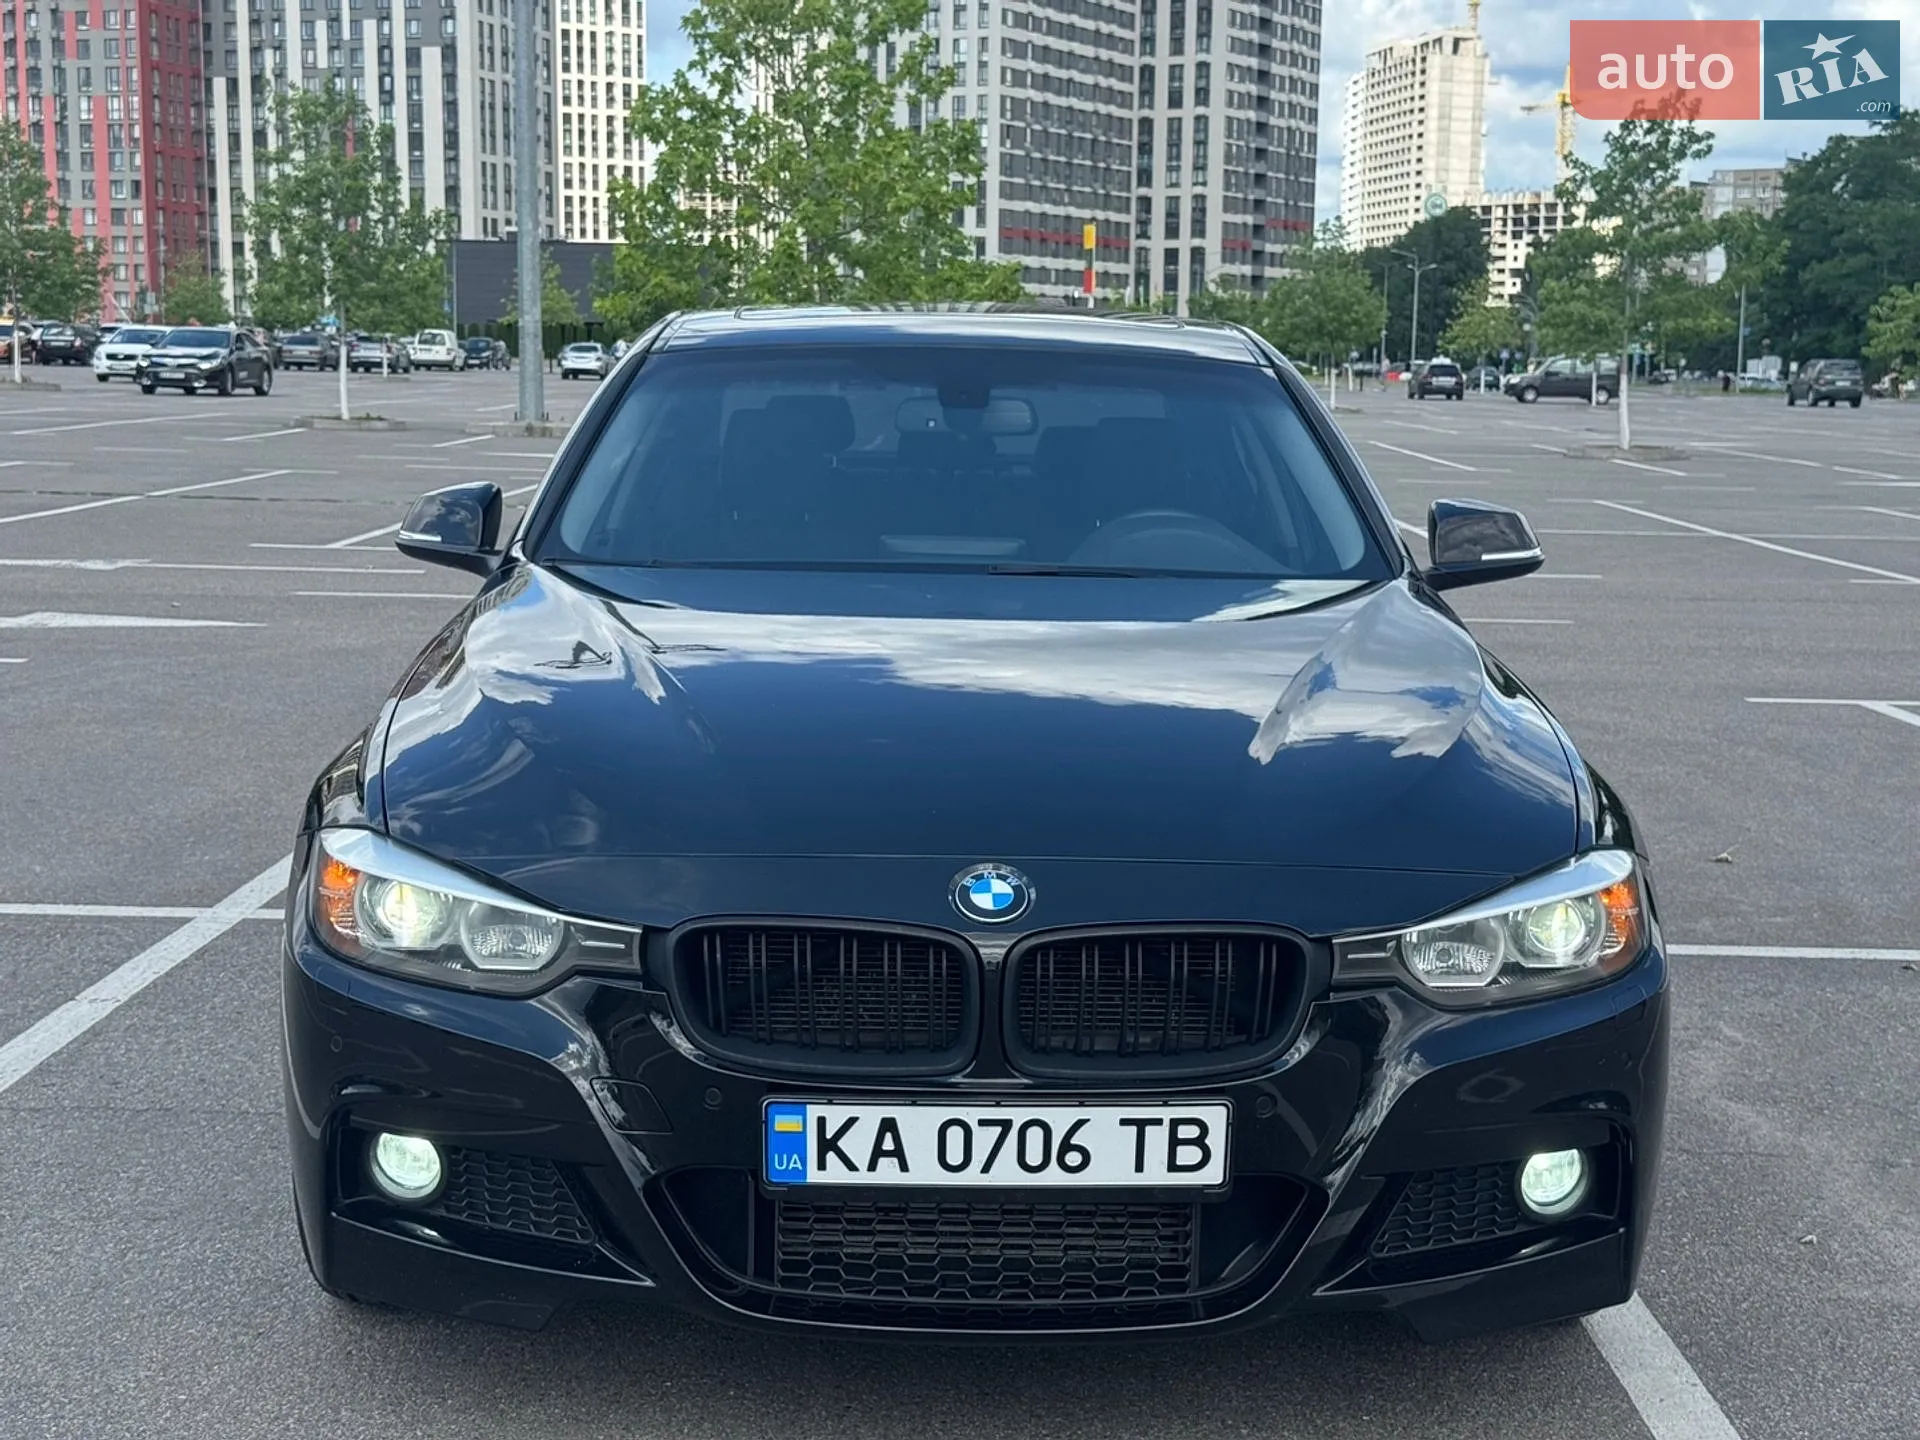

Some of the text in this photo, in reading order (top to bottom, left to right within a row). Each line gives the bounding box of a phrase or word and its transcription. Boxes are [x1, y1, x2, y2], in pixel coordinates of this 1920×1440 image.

[962, 871, 1021, 887] BMW
[815, 1115, 1212, 1175] KA 0706 TB
[774, 1153, 803, 1171] UA
